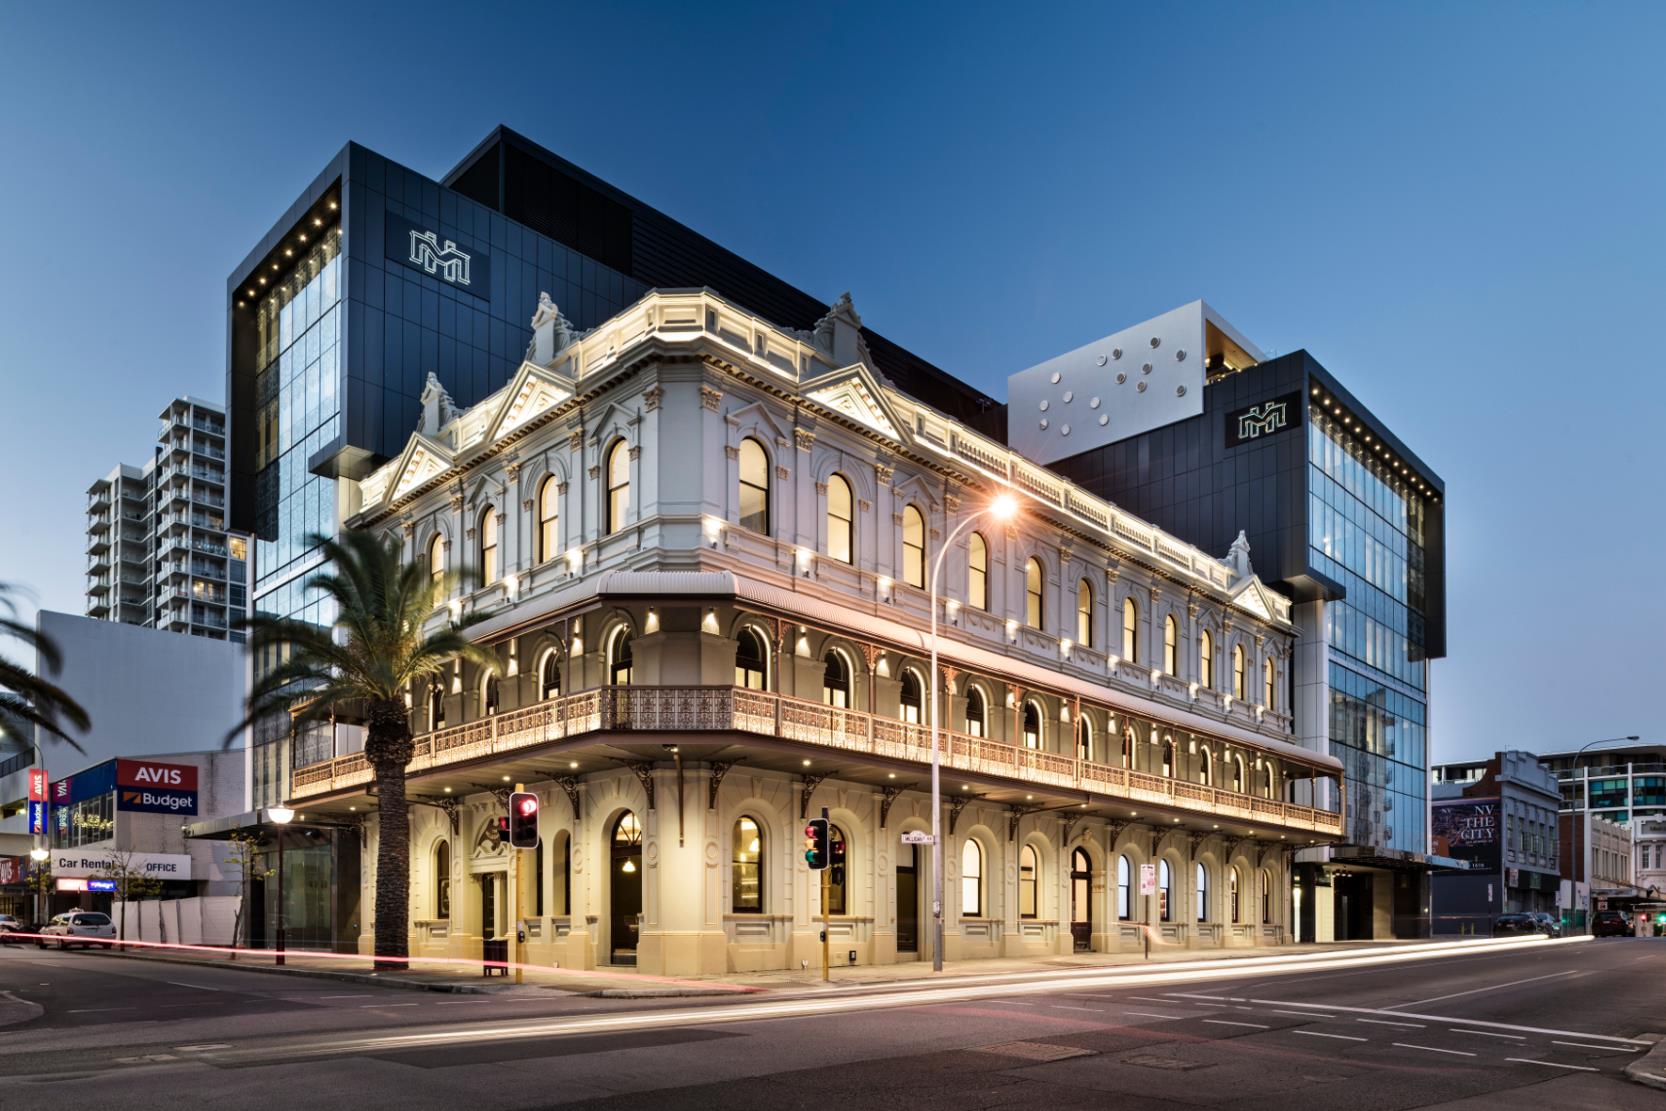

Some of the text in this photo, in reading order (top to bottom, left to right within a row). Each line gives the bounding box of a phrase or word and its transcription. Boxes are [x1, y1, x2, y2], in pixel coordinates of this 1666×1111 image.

[135, 767, 182, 785] AVIS
[34, 775, 42, 796] AVIS
[143, 793, 193, 810] Budget
[1474, 804, 1495, 816] NV
[1464, 816, 1495, 828] THE
[1460, 828, 1495, 840] CITY
[59, 858, 177, 872] Car Rental OFFICE
